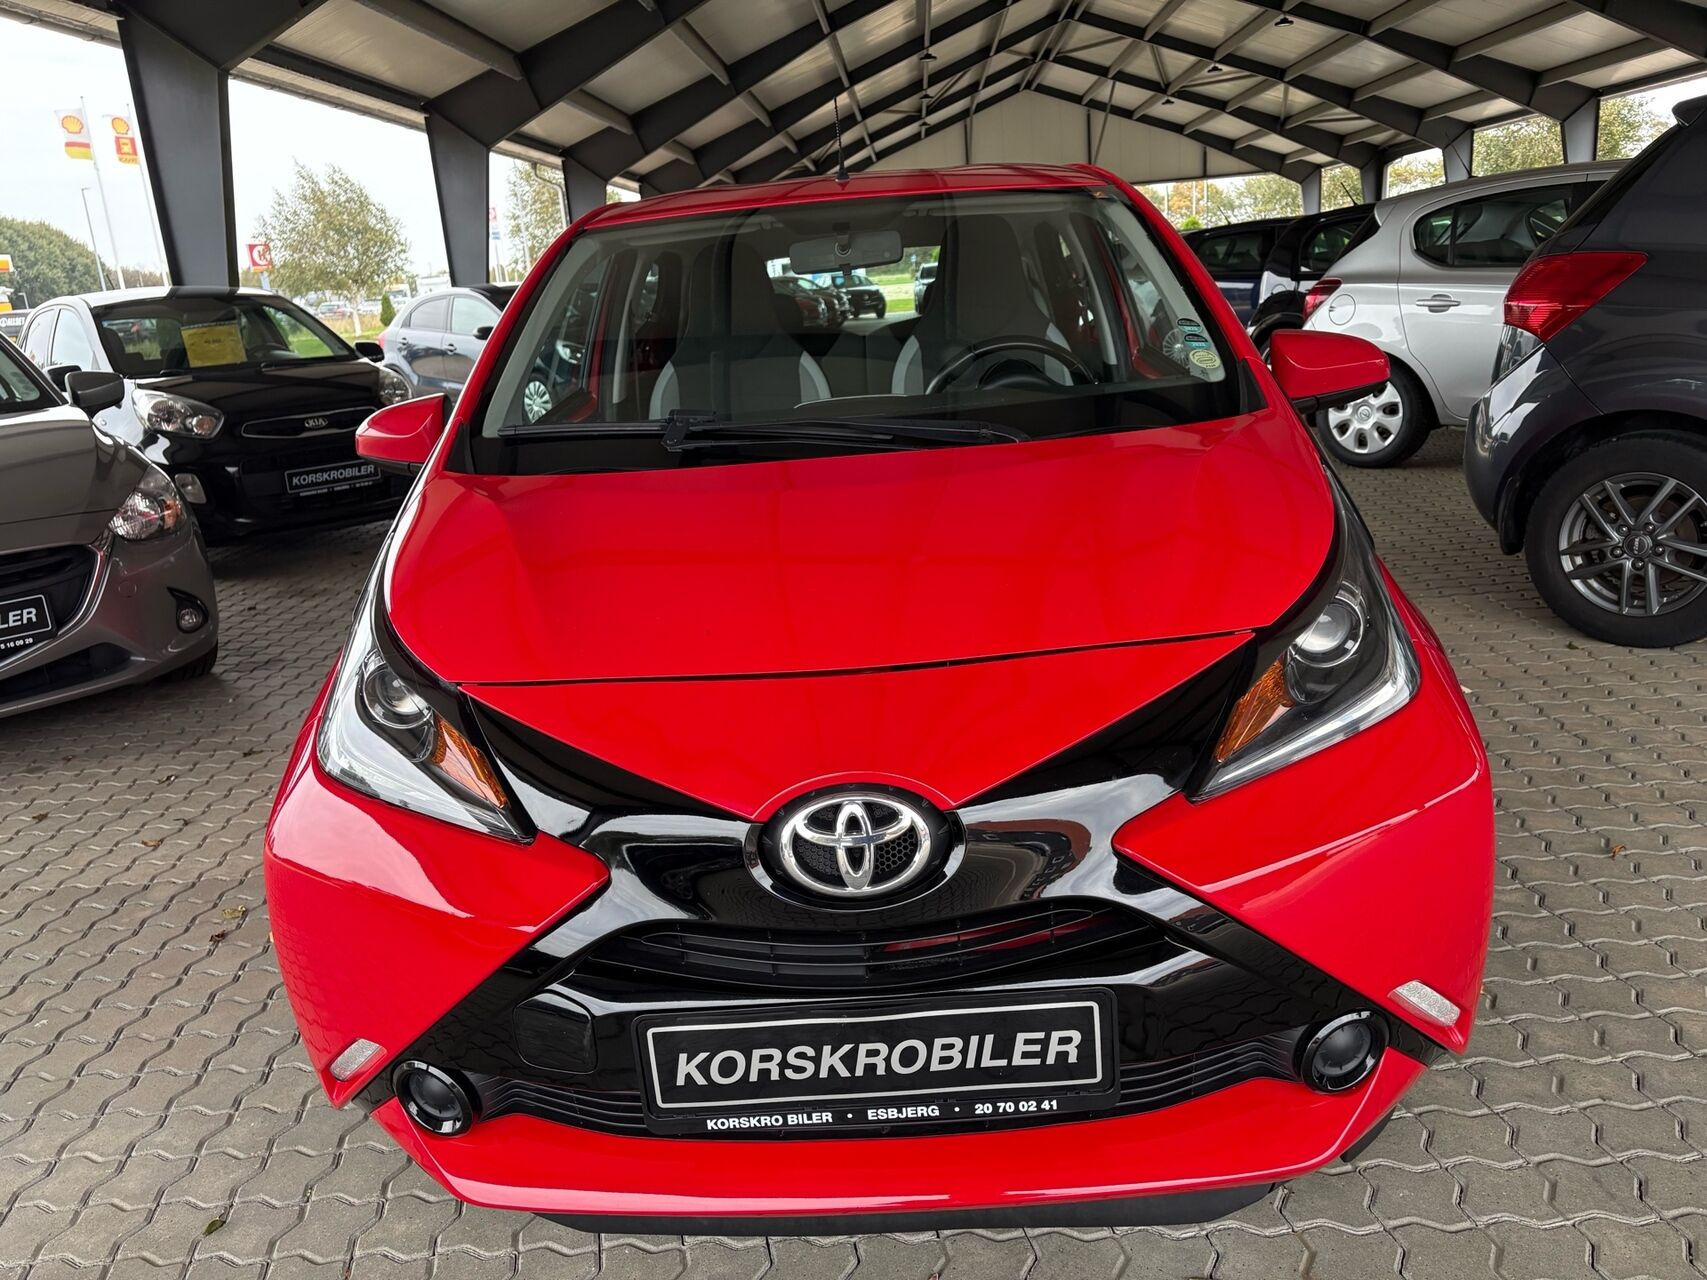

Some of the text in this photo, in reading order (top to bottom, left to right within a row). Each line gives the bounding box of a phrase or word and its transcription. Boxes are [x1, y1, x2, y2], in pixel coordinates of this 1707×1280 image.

[307, 417, 326, 428] KIA
[292, 464, 375, 486] KORSKROBILER
[676, 1029, 1082, 1086] KORSKROBILER
[706, 1099, 1058, 1130] KORSKRO BILER ESBJERG 20 70 02 41
